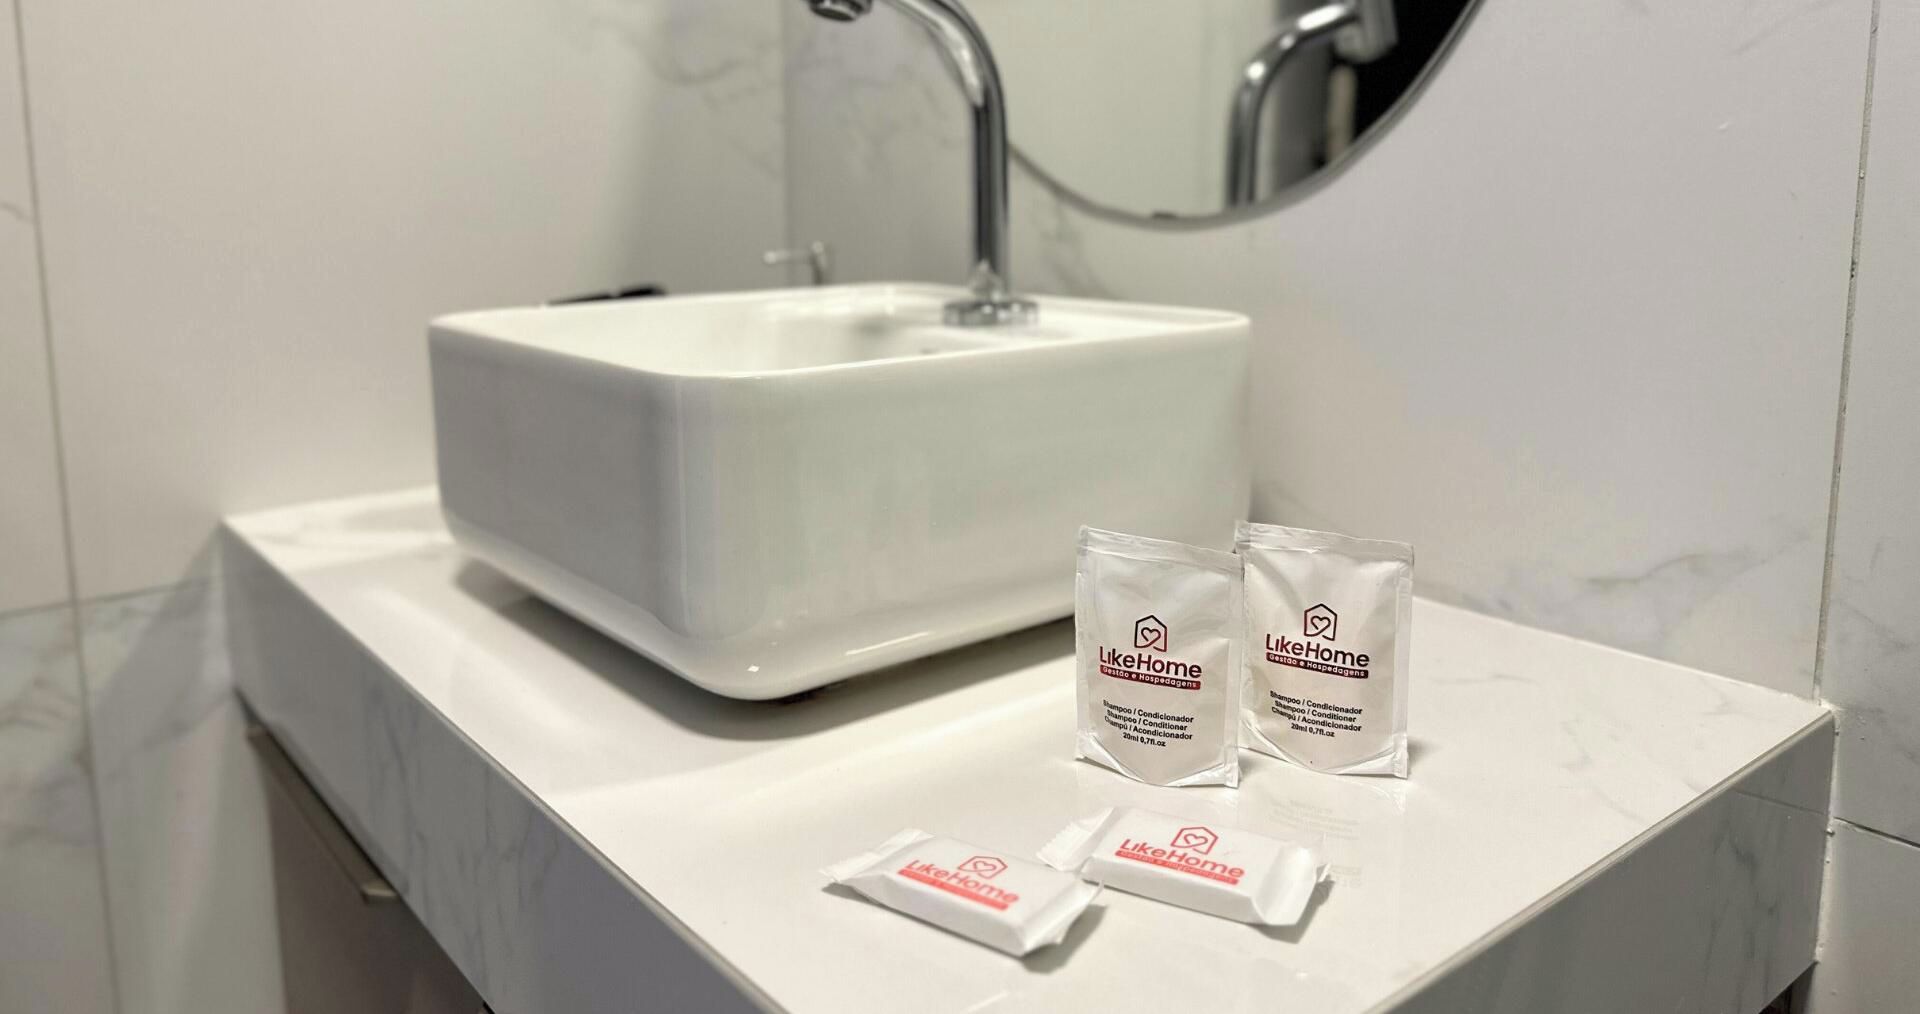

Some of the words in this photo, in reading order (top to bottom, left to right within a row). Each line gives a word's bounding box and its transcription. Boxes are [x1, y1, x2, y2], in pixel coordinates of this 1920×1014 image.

[1266, 634, 1369, 667] LikeHome
[1100, 646, 1202, 678] LikeHome
[1269, 654, 1297, 666] Gestão
[1307, 663, 1365, 677] Hospedagens
[1102, 666, 1129, 679] Gestão
[1139, 673, 1197, 688] Hospedagens
[1103, 699, 1133, 715] Shampoo
[1137, 709, 1194, 723] Condicionador
[1270, 690, 1301, 706] Shampoo
[1306, 700, 1363, 715] Condicionador
[1275, 701, 1306, 716] Shampoo
[1311, 710, 1357, 723] Conditioner
[1107, 709, 1137, 725] Shampoo
[1142, 719, 1188, 731] Conditioner
[1291, 723, 1307, 733] 20ml
[1301, 716, 1362, 731] Acondicionador
[1123, 732, 1139, 743] 20ml
[1133, 725, 1192, 740] Acondicionador
[1119, 838, 1245, 878] LikeHome
[905, 859, 1019, 903] LikeHome
